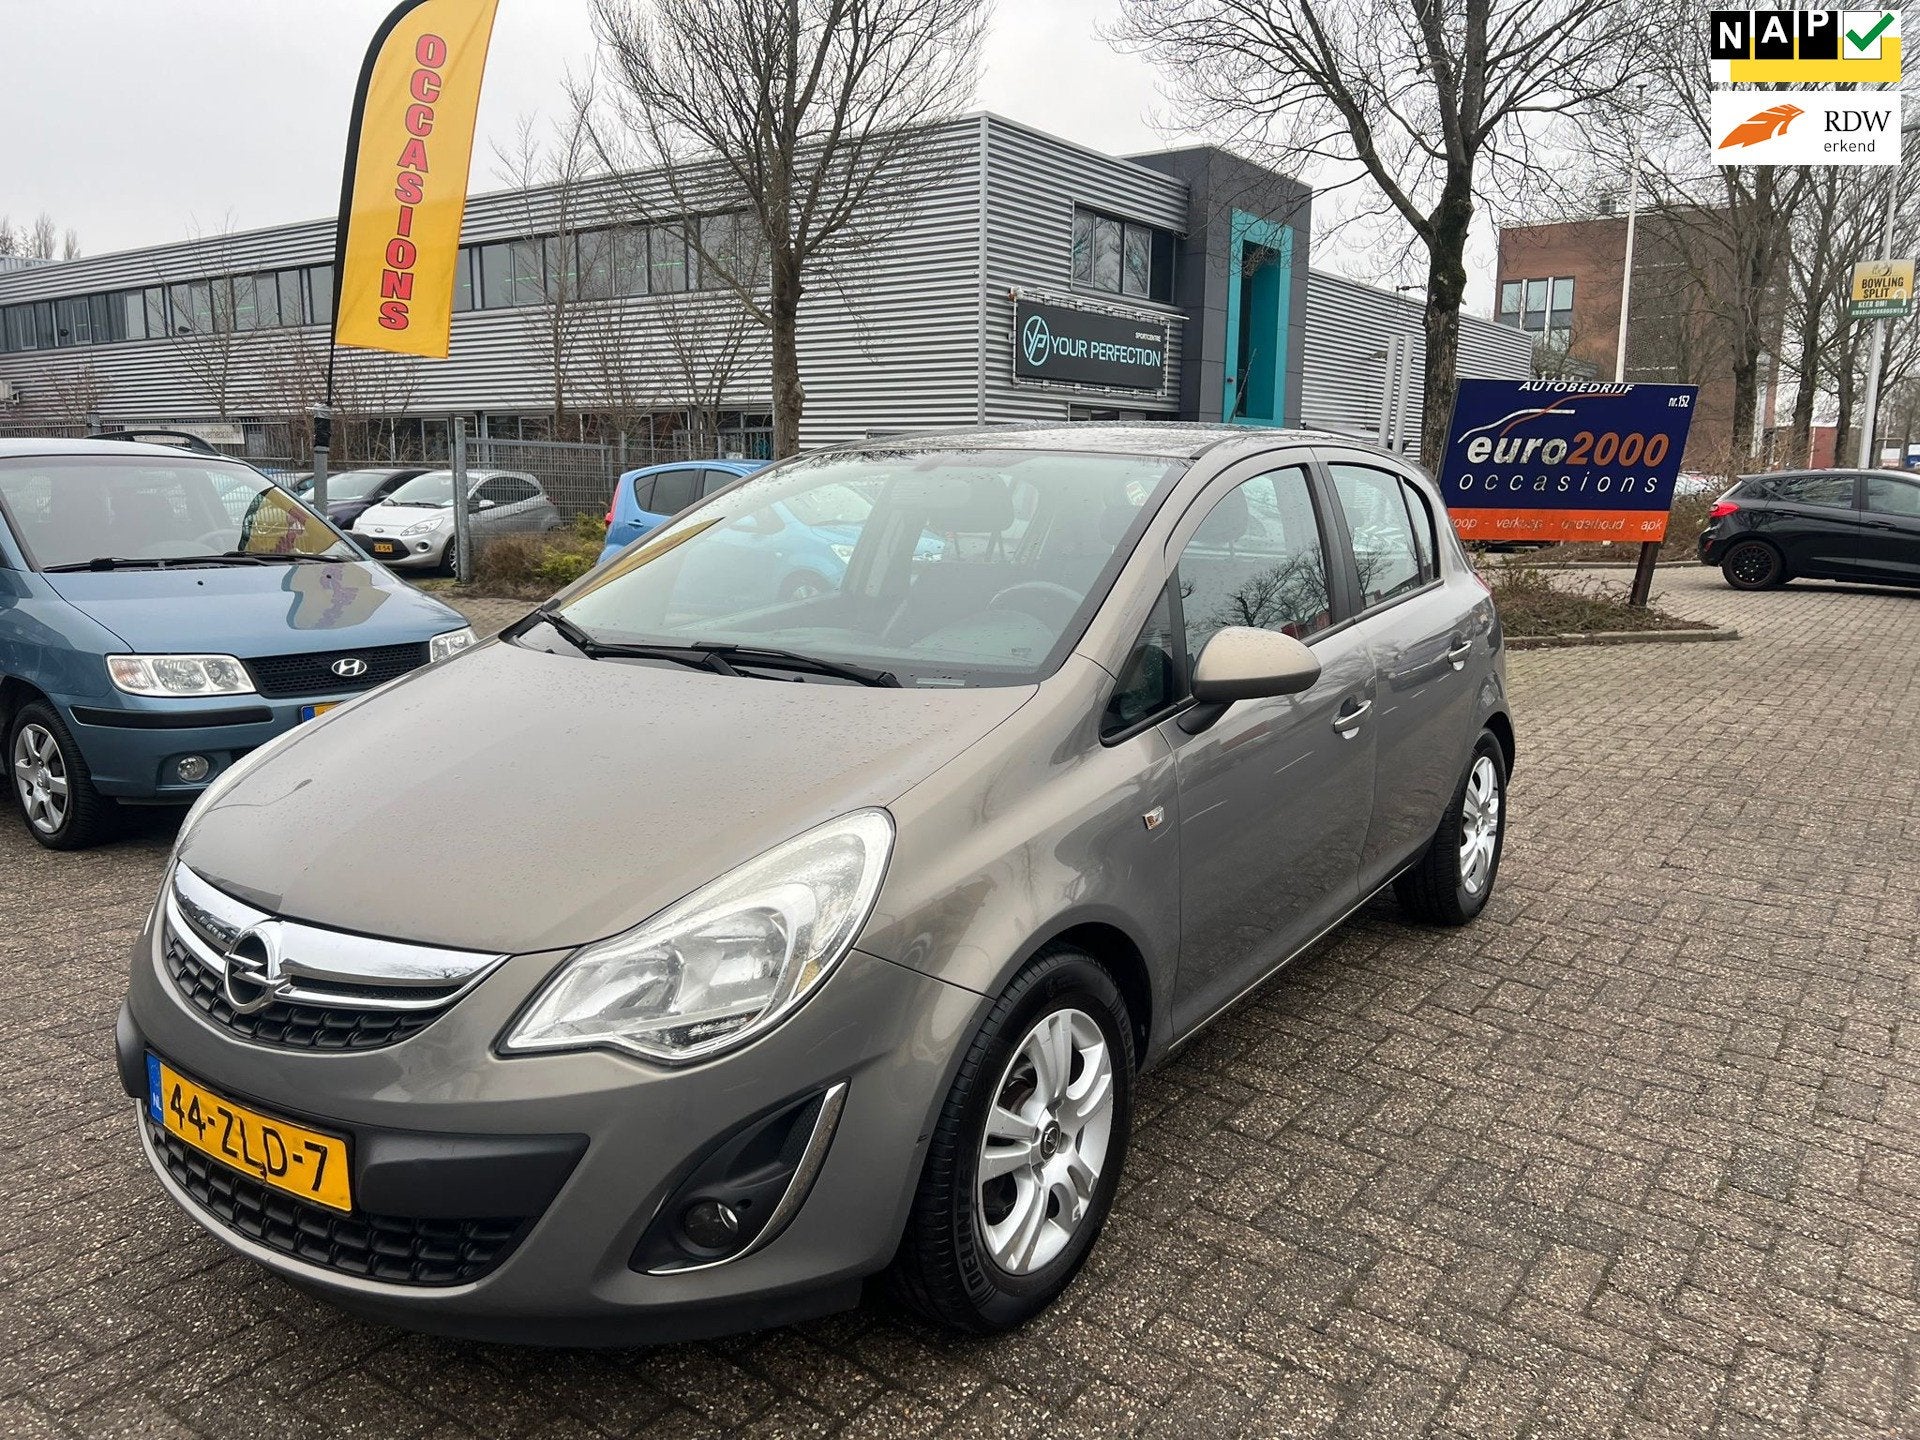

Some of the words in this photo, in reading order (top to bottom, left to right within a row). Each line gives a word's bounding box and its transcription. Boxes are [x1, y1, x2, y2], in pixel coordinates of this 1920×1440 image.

[378, 33, 447, 331] OCCASIONS
[1862, 277, 1904, 289] BOWLING
[1863, 288, 1890, 299] SPLIT
[1051, 335, 1088, 359] YOUR
[1090, 342, 1161, 367] PERFECTION
[1518, 381, 1635, 394] AUTOBEDRIJF
[1467, 431, 1669, 467] euro2000
[1459, 471, 1658, 493] occasions
[1640, 519, 1663, 532] apk
[170, 1083, 328, 1192] 44-ZLD-7
